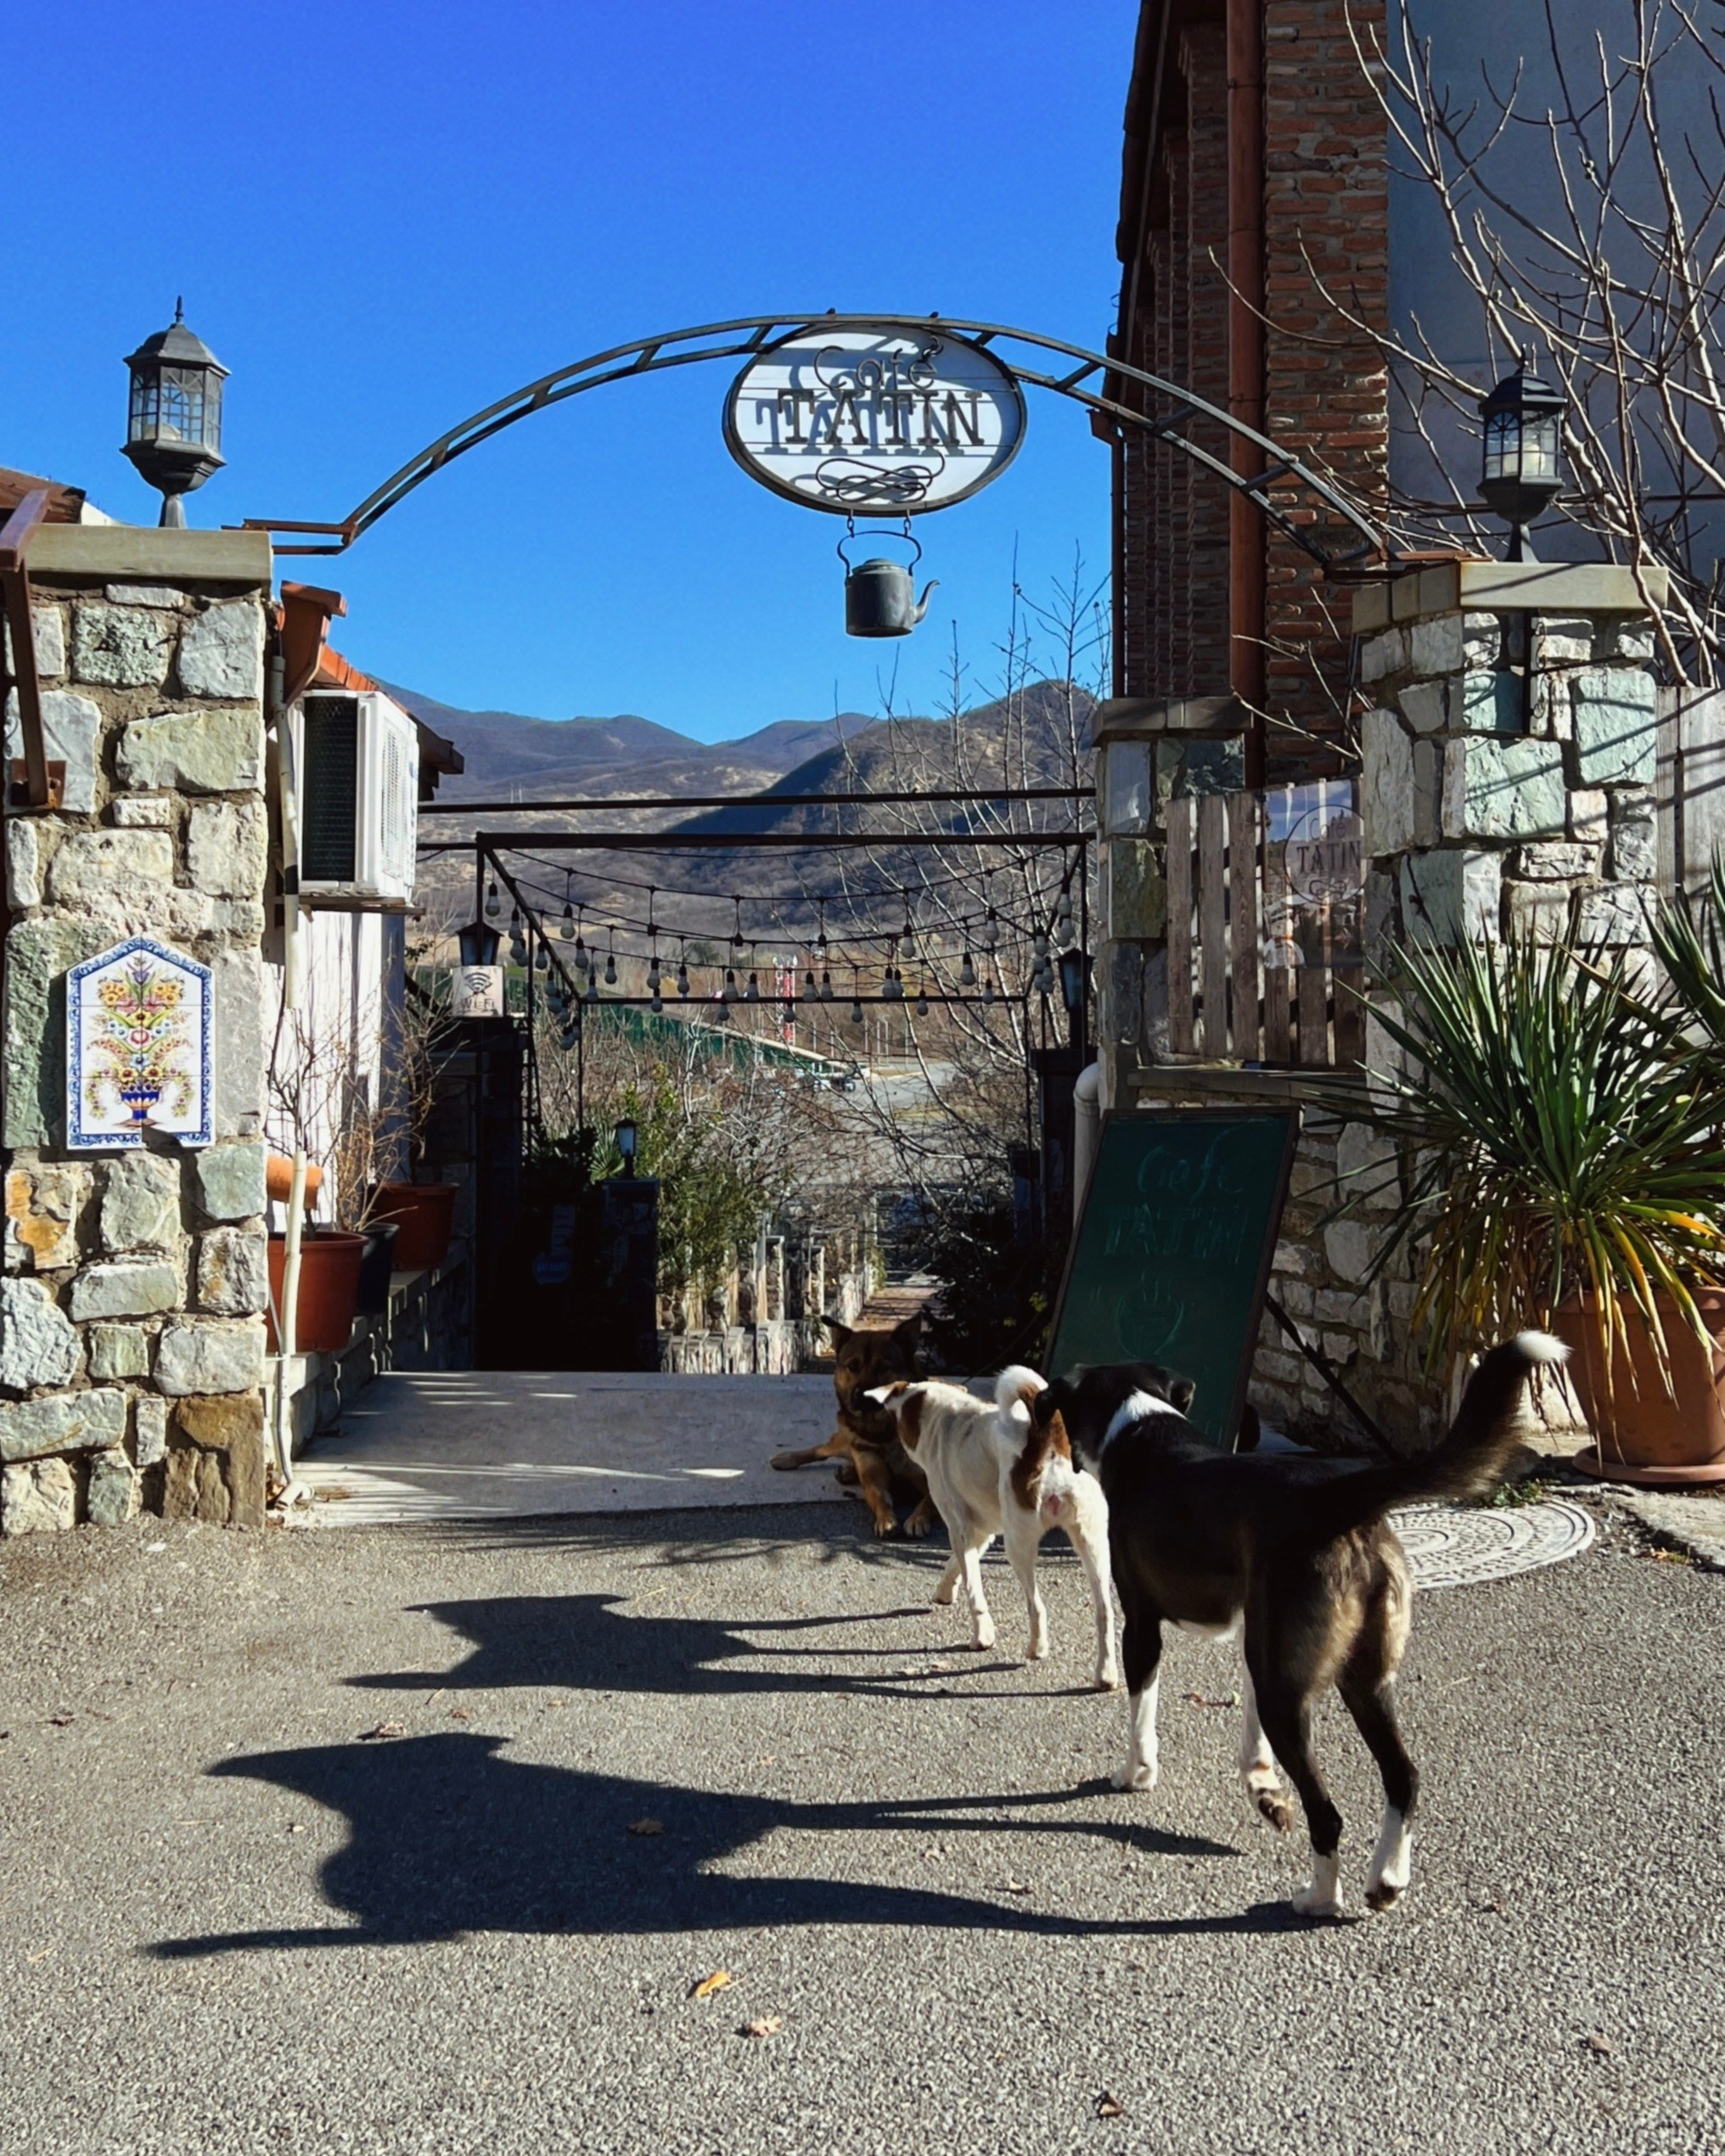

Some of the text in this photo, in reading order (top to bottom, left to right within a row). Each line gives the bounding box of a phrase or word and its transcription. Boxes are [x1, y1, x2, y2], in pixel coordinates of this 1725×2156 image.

[813, 336, 944, 390] Café
[778, 389, 986, 446] TATIN
[1296, 839, 1361, 873] TATIN
